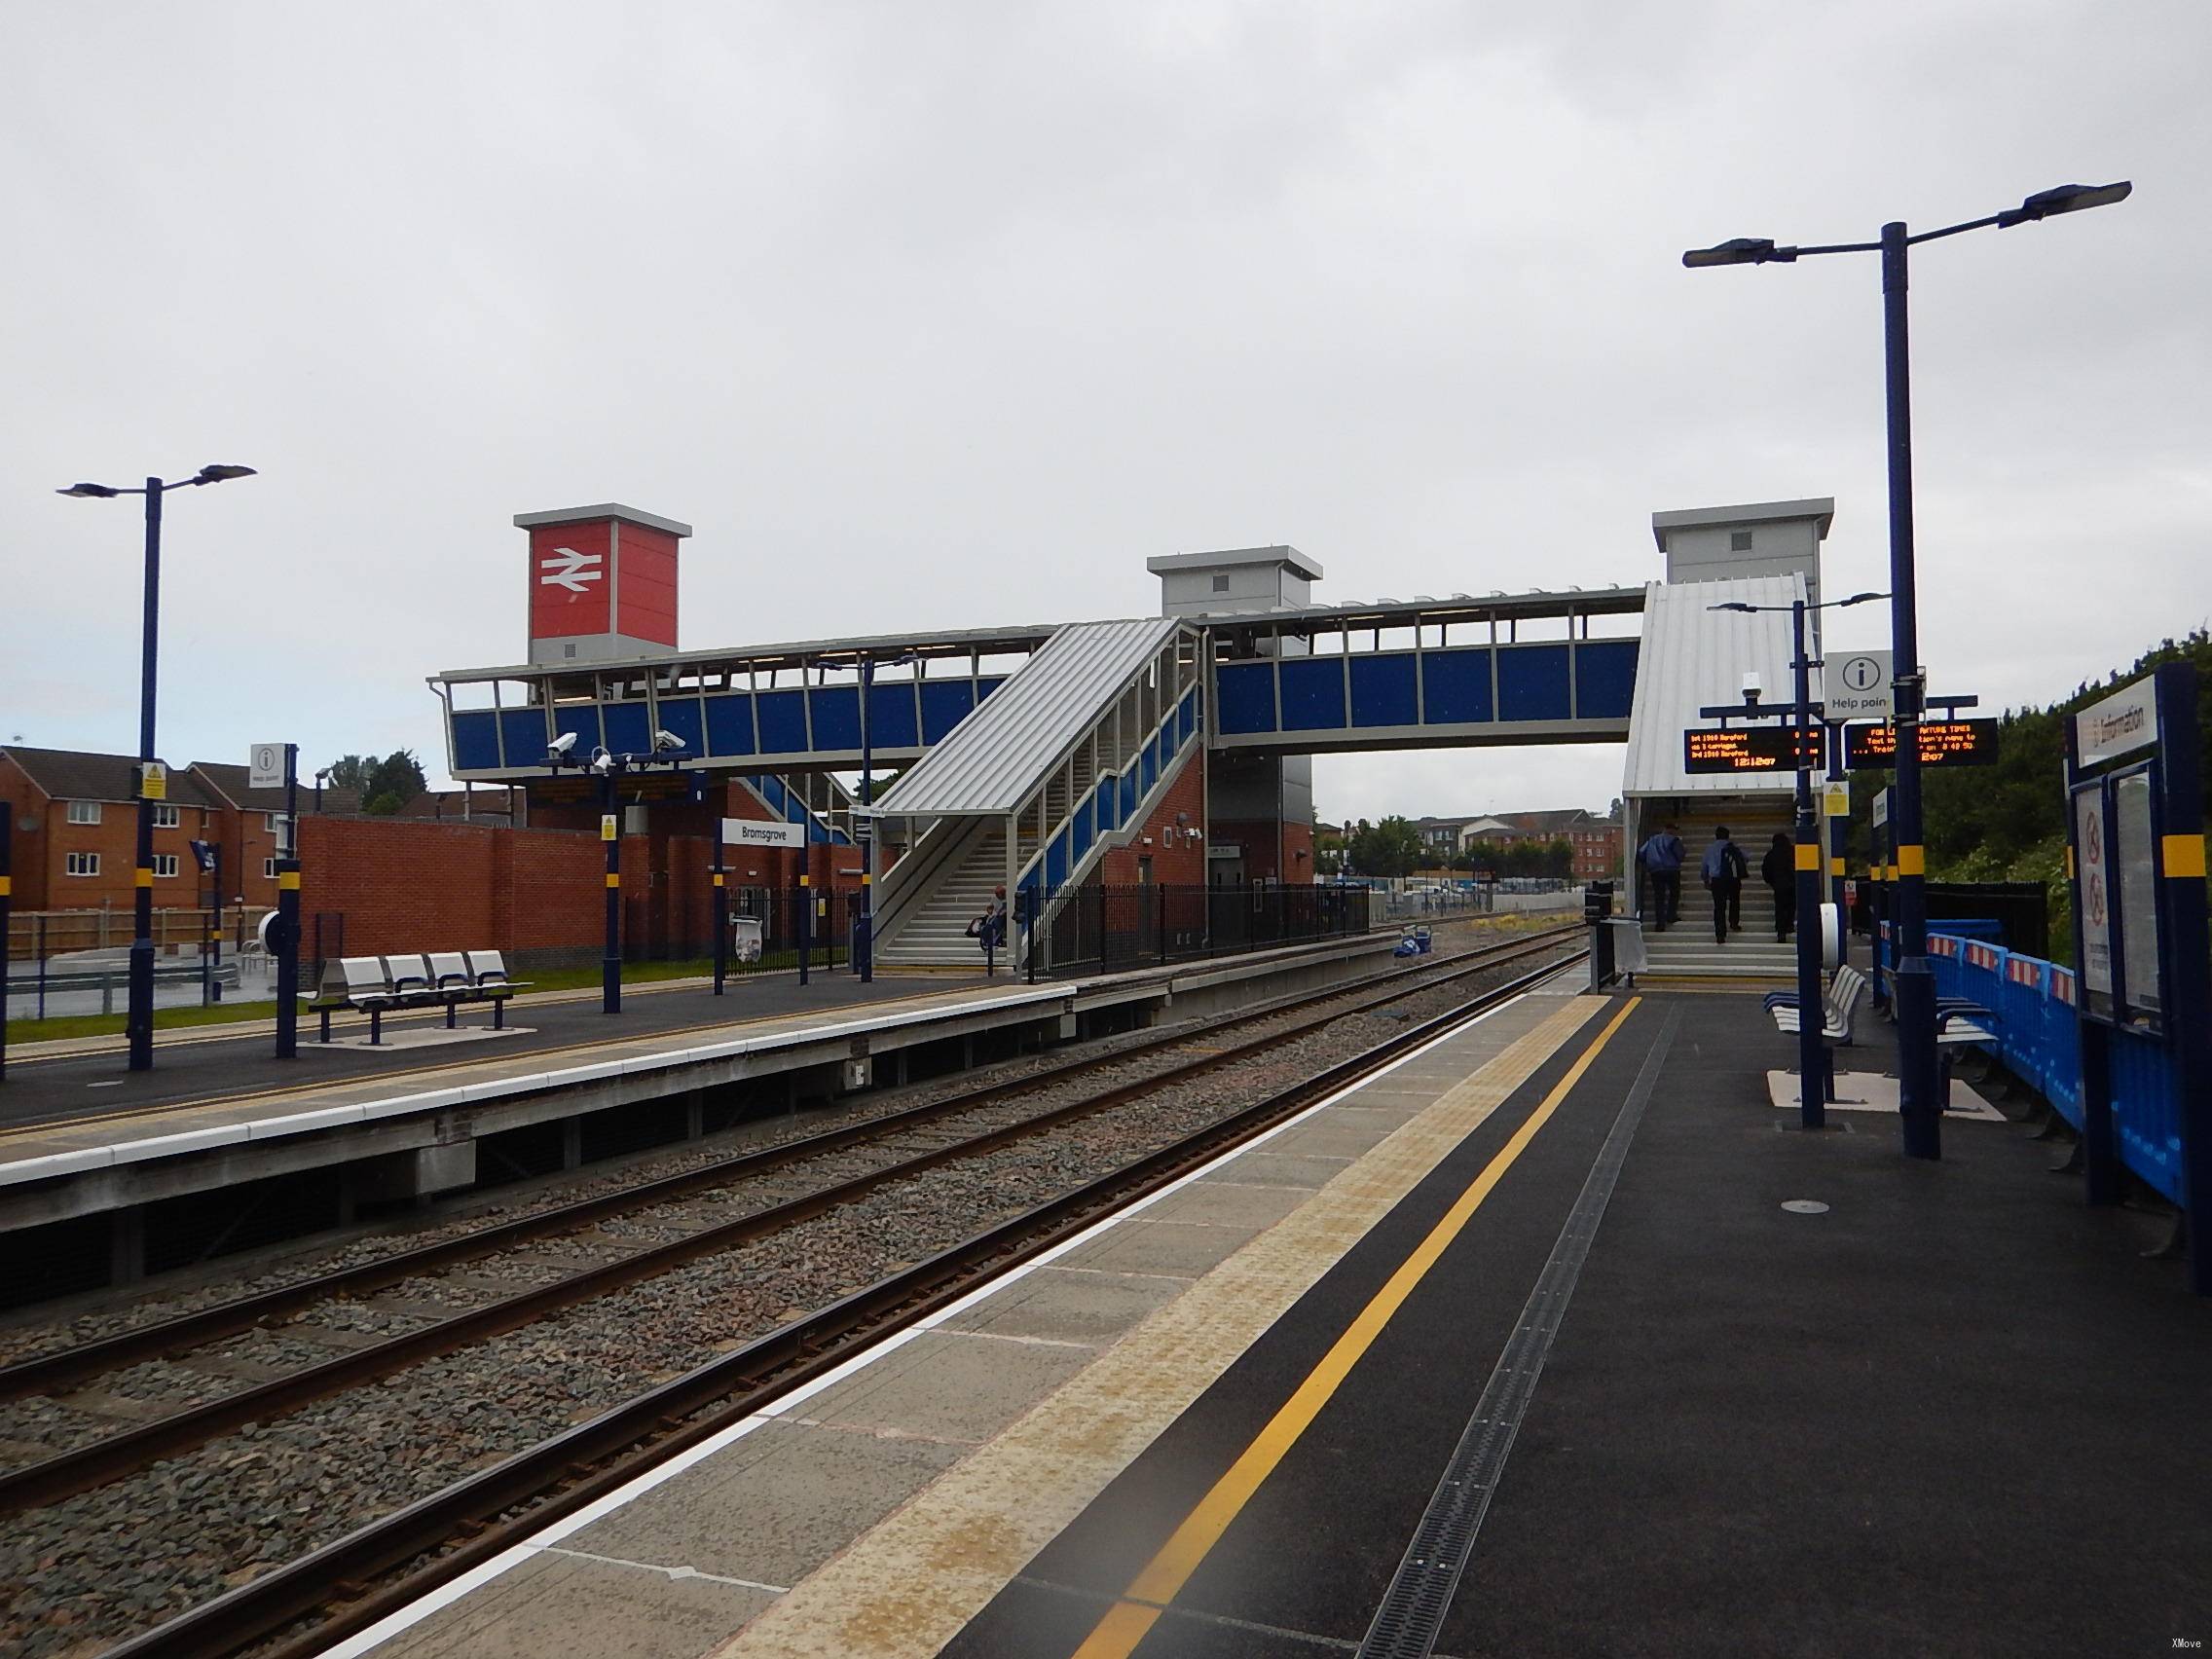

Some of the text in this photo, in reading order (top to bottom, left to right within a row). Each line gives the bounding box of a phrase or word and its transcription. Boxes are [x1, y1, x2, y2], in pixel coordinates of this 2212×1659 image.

[1832, 697, 1887, 710] Help poin
[1919, 725, 1947, 734] ARTURE
[1918, 734, 1942, 743] tion's
[1966, 732, 1976, 741] to
[742, 826, 787, 843] Bromsgrove
